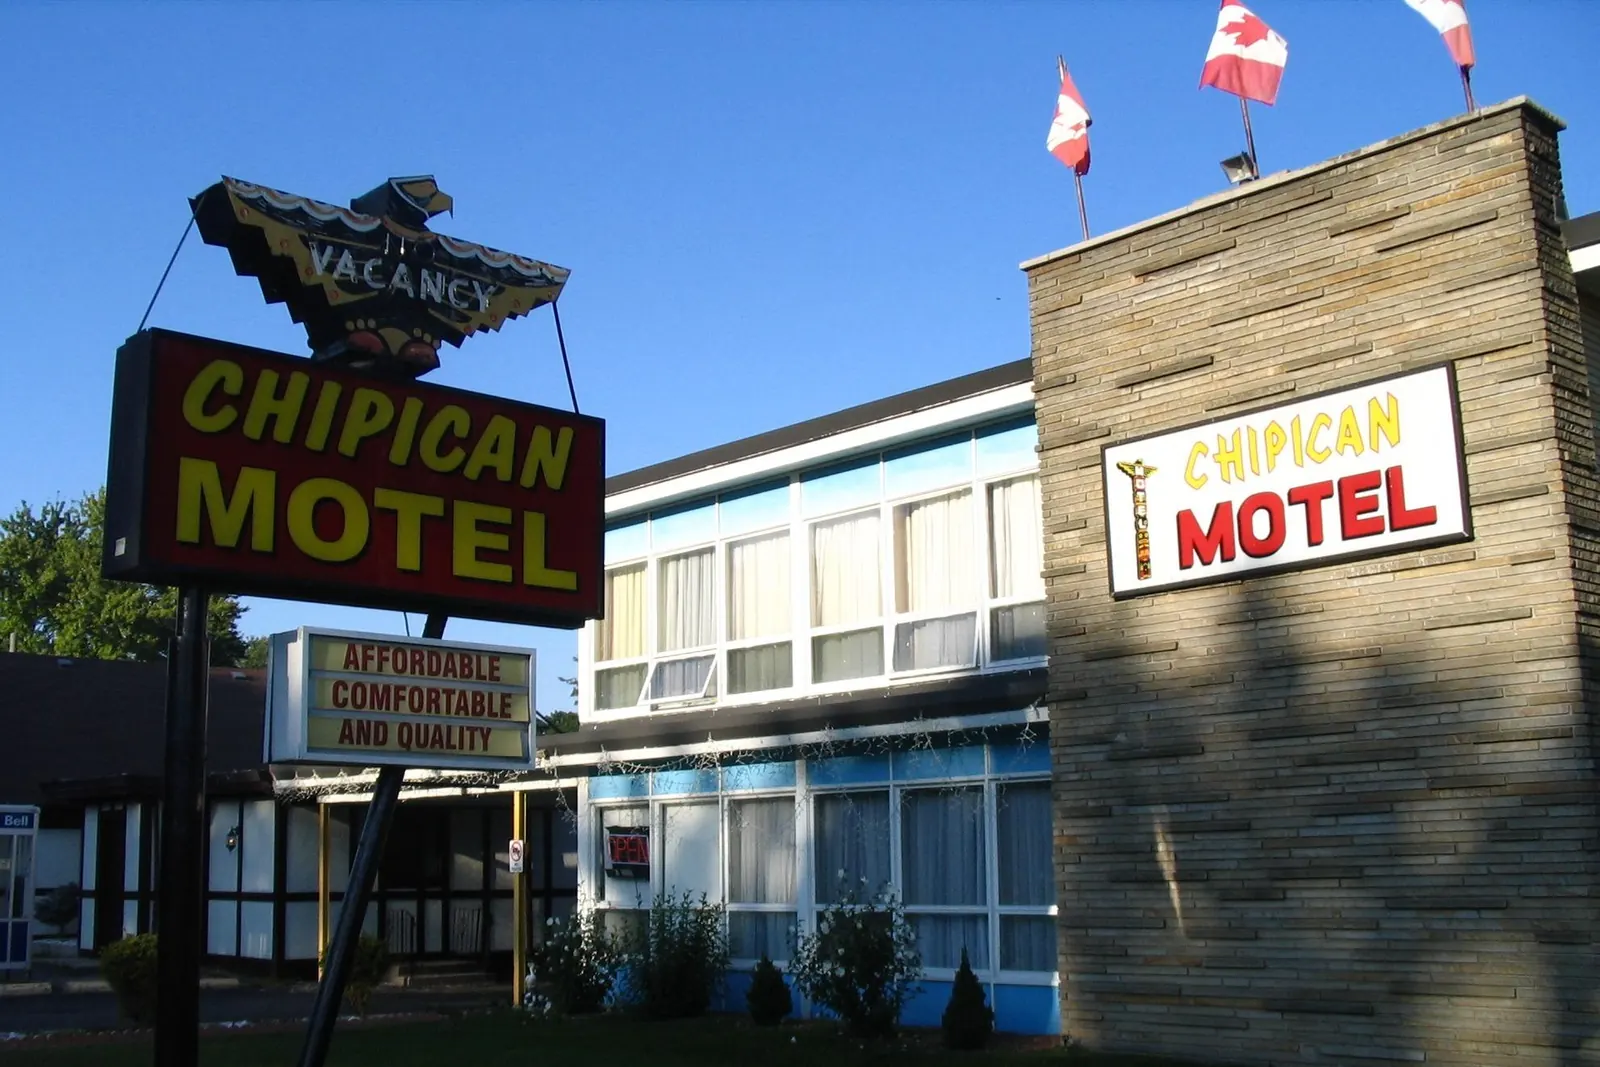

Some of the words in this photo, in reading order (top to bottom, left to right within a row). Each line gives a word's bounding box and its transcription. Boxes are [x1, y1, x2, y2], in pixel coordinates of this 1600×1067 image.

[308, 240, 498, 313] VACANCY
[182, 359, 575, 491] CHIPICAN
[1183, 391, 1401, 490] CHIPICAN
[176, 456, 578, 591] MOTEL
[1176, 465, 1438, 570] MOTEL
[342, 642, 501, 682] AFFORDABLE
[332, 679, 512, 719] COMFORTABLE
[338, 718, 389, 747] AND
[397, 721, 492, 752] QUALITY
[5, 815, 28, 826] Bell
